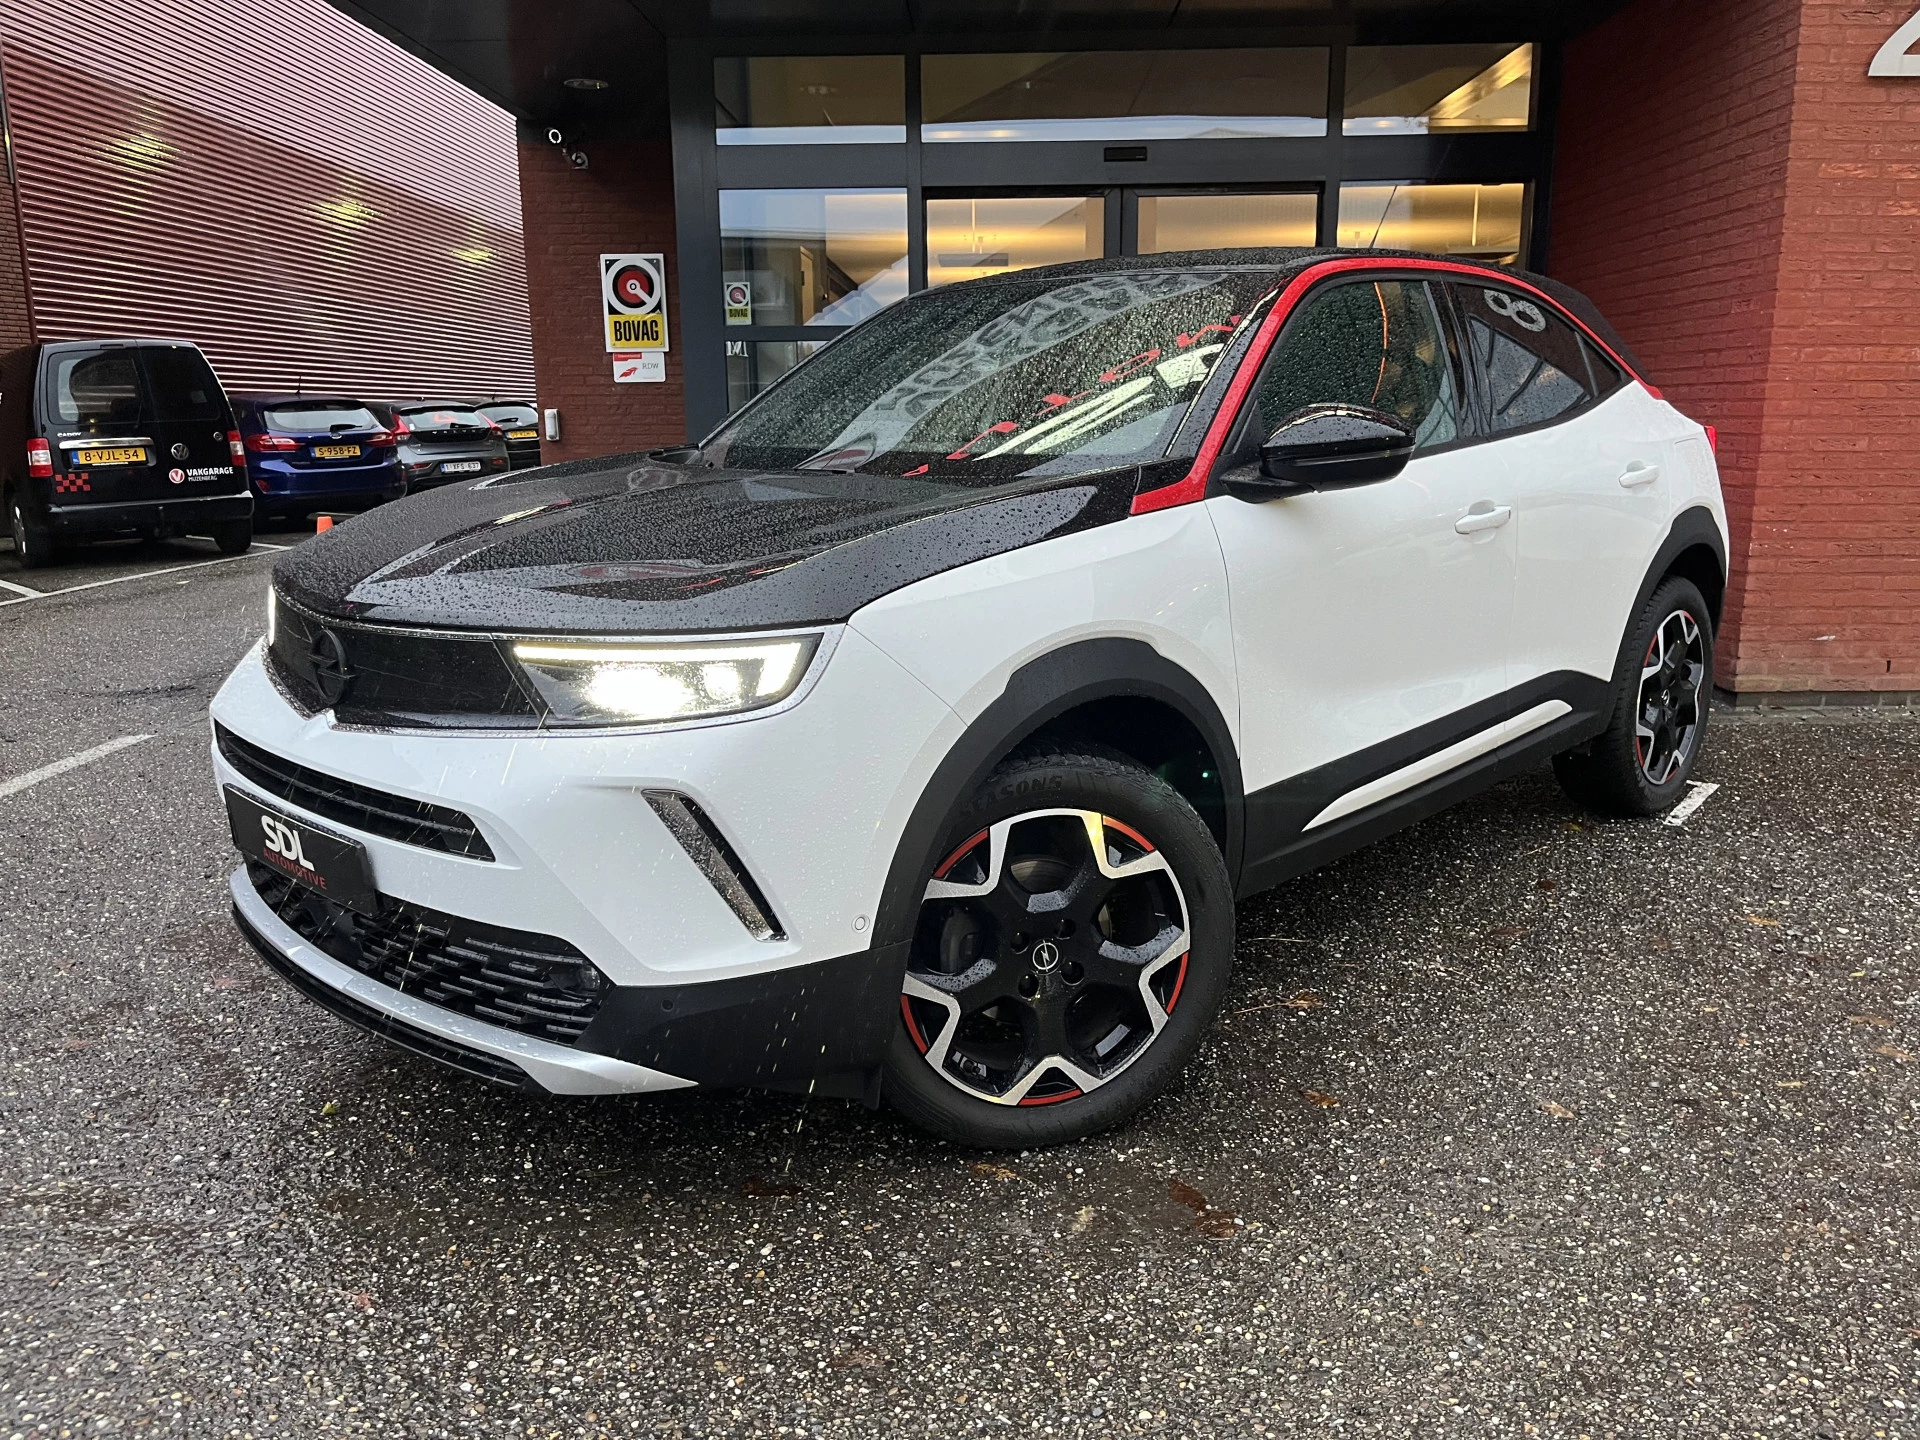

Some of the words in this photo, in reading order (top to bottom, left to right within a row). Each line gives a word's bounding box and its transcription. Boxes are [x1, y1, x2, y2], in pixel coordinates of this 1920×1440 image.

[729, 307, 748, 318] BOVAG
[613, 319, 659, 342] BOVAG
[641, 362, 659, 370] RDW
[84, 450, 140, 462] 8-VJL-54
[318, 446, 358, 456] S-958-FZ
[186, 466, 234, 477] VAKGARAGE
[261, 814, 315, 872] SDL
[263, 846, 328, 890] AUTOMOTIVE
